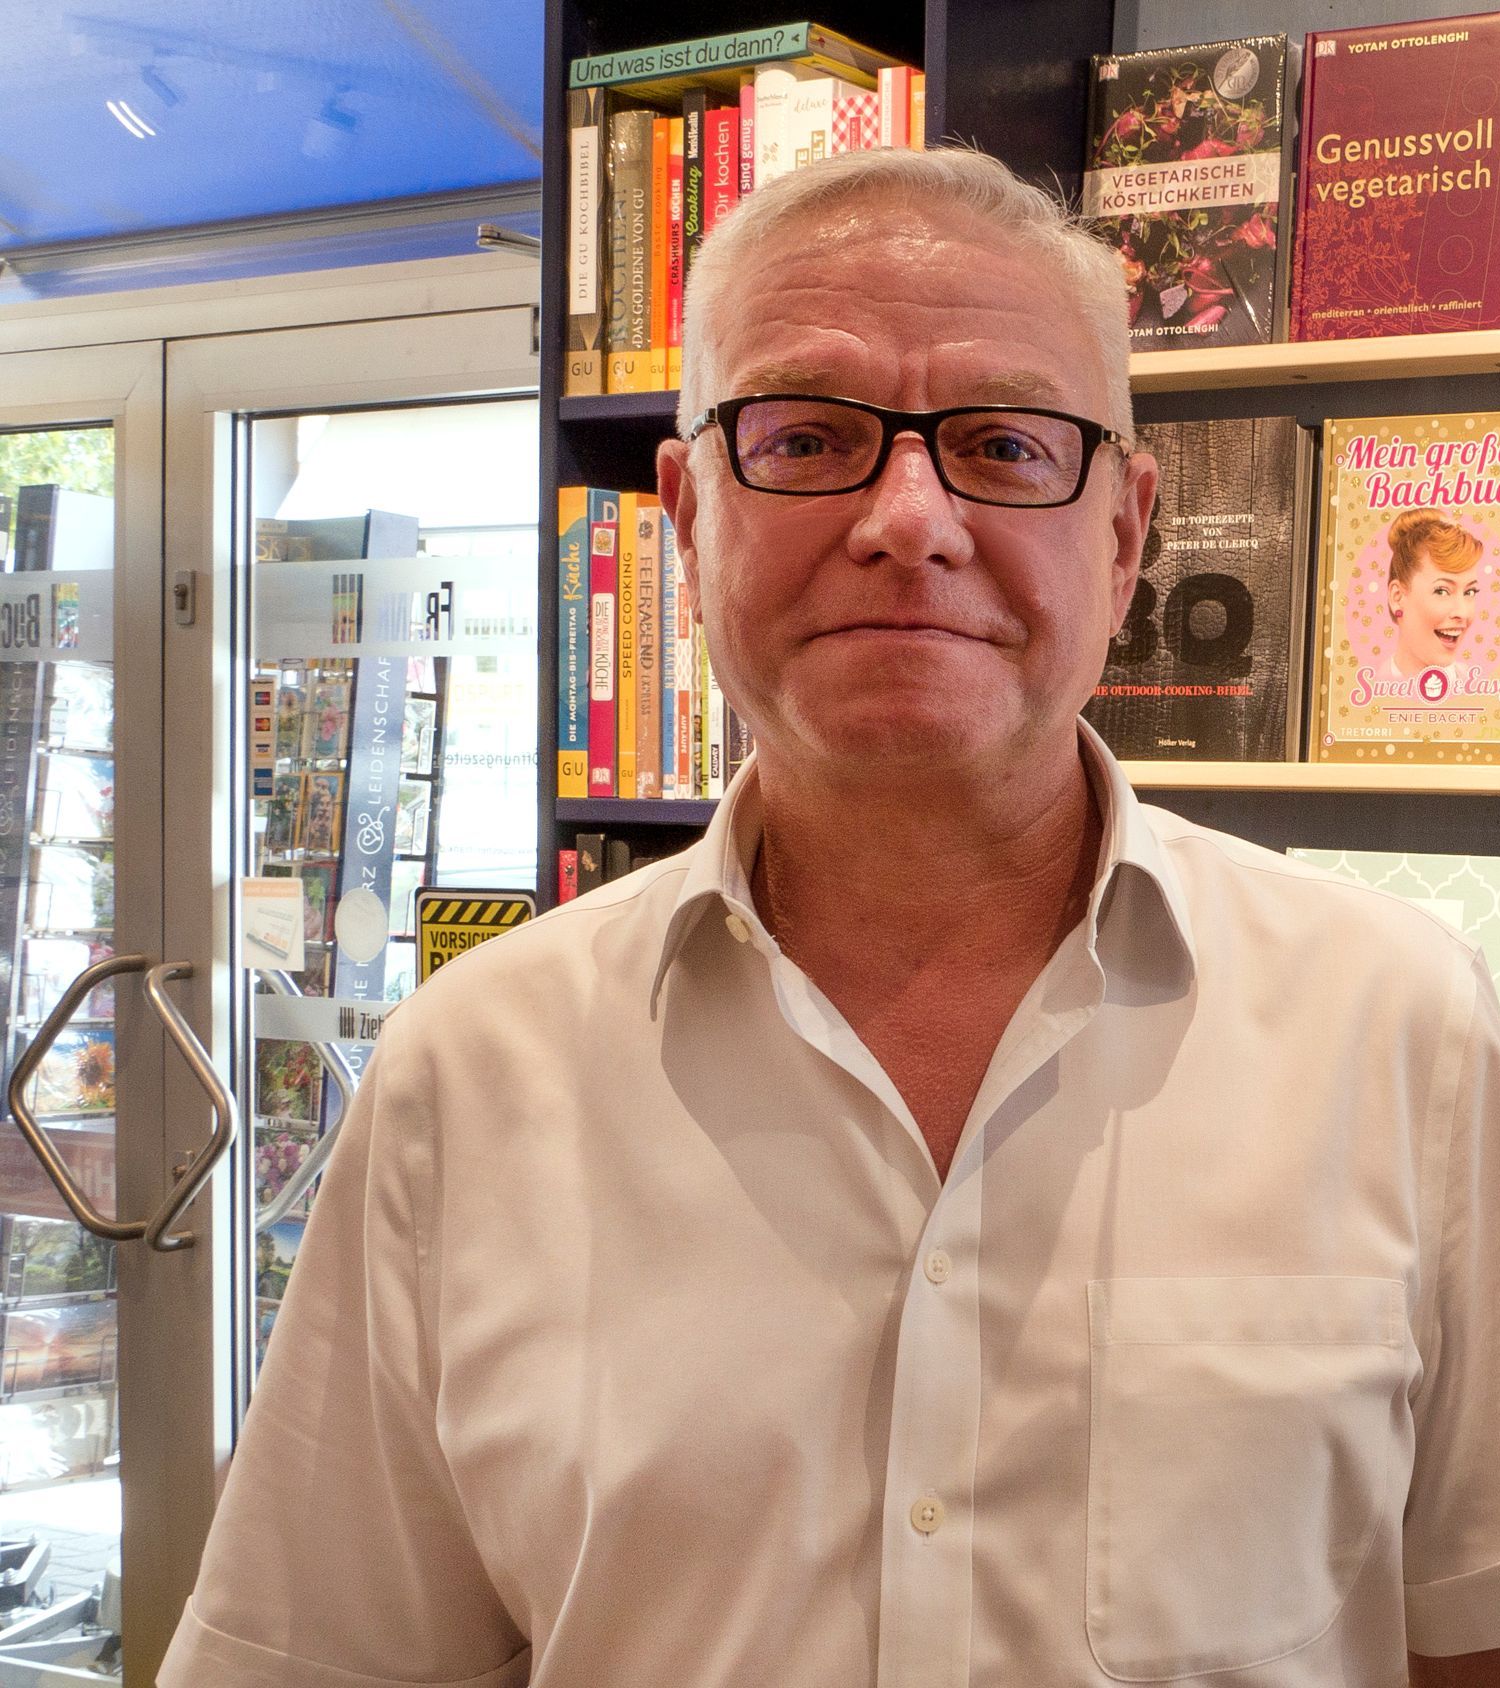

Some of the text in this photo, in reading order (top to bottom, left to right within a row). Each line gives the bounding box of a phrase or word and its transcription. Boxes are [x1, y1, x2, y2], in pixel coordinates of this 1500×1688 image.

[576, 30, 785, 81] Und was isst du dann?
[1348, 31, 1469, 54] YOTAM OTTOLENGHI
[714, 121, 729, 187] kochen
[1316, 118, 1493, 165] Genussvoll
[1112, 164, 1246, 188] VEGETARISCHE
[1316, 160, 1491, 208] vegetarisch
[632, 188, 645, 208] GU
[686, 164, 702, 236] Cooking
[1102, 183, 1254, 210] KÖSTLICHKEITEN
[633, 210, 645, 244] VON
[671, 179, 681, 285] CRASHKURS KOCHEN
[632, 246, 645, 316] GOLDENE
[1312, 300, 1482, 319] mediterran orientalisch raffiniert
[1347, 436, 1424, 470] Mein
[1172, 514, 1255, 525] 101 TOPREZEPTE
[1203, 528, 1223, 536] VON
[1167, 538, 1259, 551] PETER DE CLERCQ
[622, 552, 632, 678] SPEED COOKING
[564, 542, 580, 741] DIE MONTAG-BIS-FREITAG Küche
[368, 655, 391, 806] LEIDENSCHAF
[1340, 727, 1392, 737] TRETORRI
[1389, 713, 1477, 723] ENIE BACKT
[1158, 739, 1196, 748] Hölker Verlag
